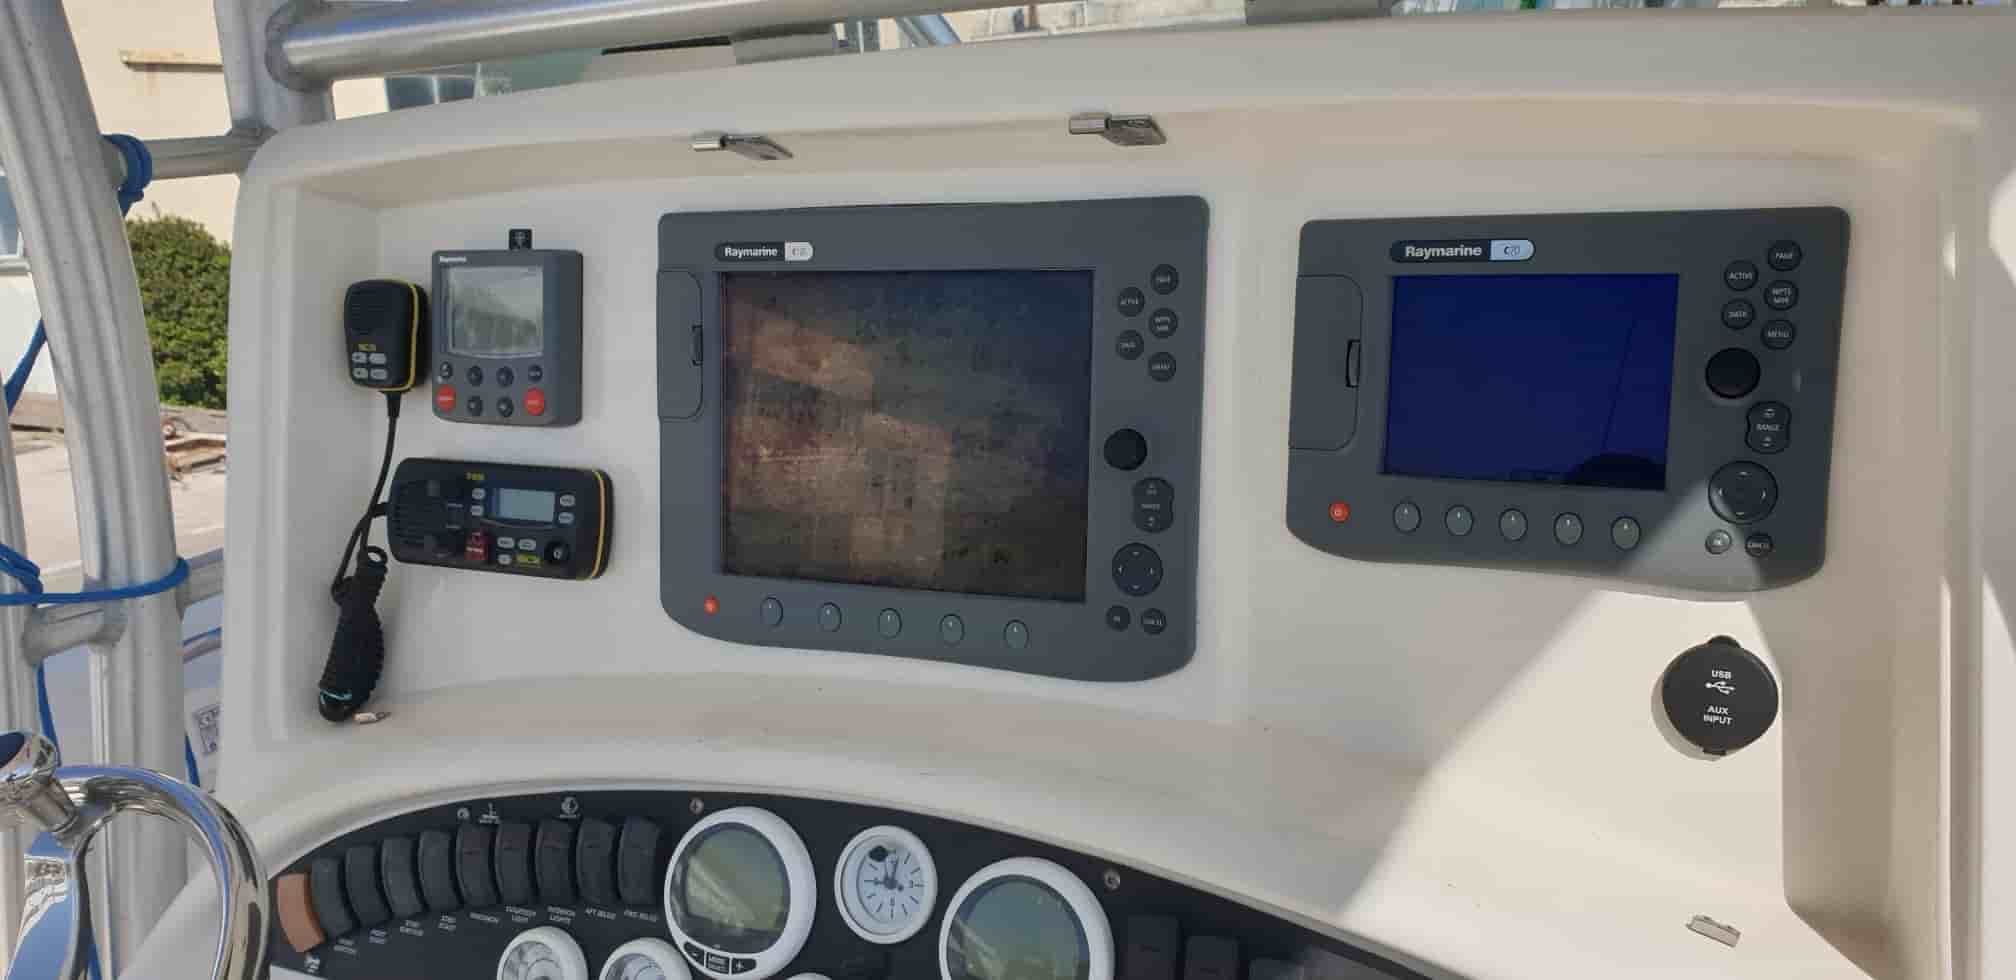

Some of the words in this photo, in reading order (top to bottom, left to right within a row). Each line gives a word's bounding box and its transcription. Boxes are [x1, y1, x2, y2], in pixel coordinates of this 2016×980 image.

[724, 246, 778, 259] Raymarine
[1405, 244, 1482, 260] Raymarine
[1711, 670, 1731, 679] USB
[1707, 705, 1728, 715] AUX
[1703, 714, 1732, 725] INPUT
